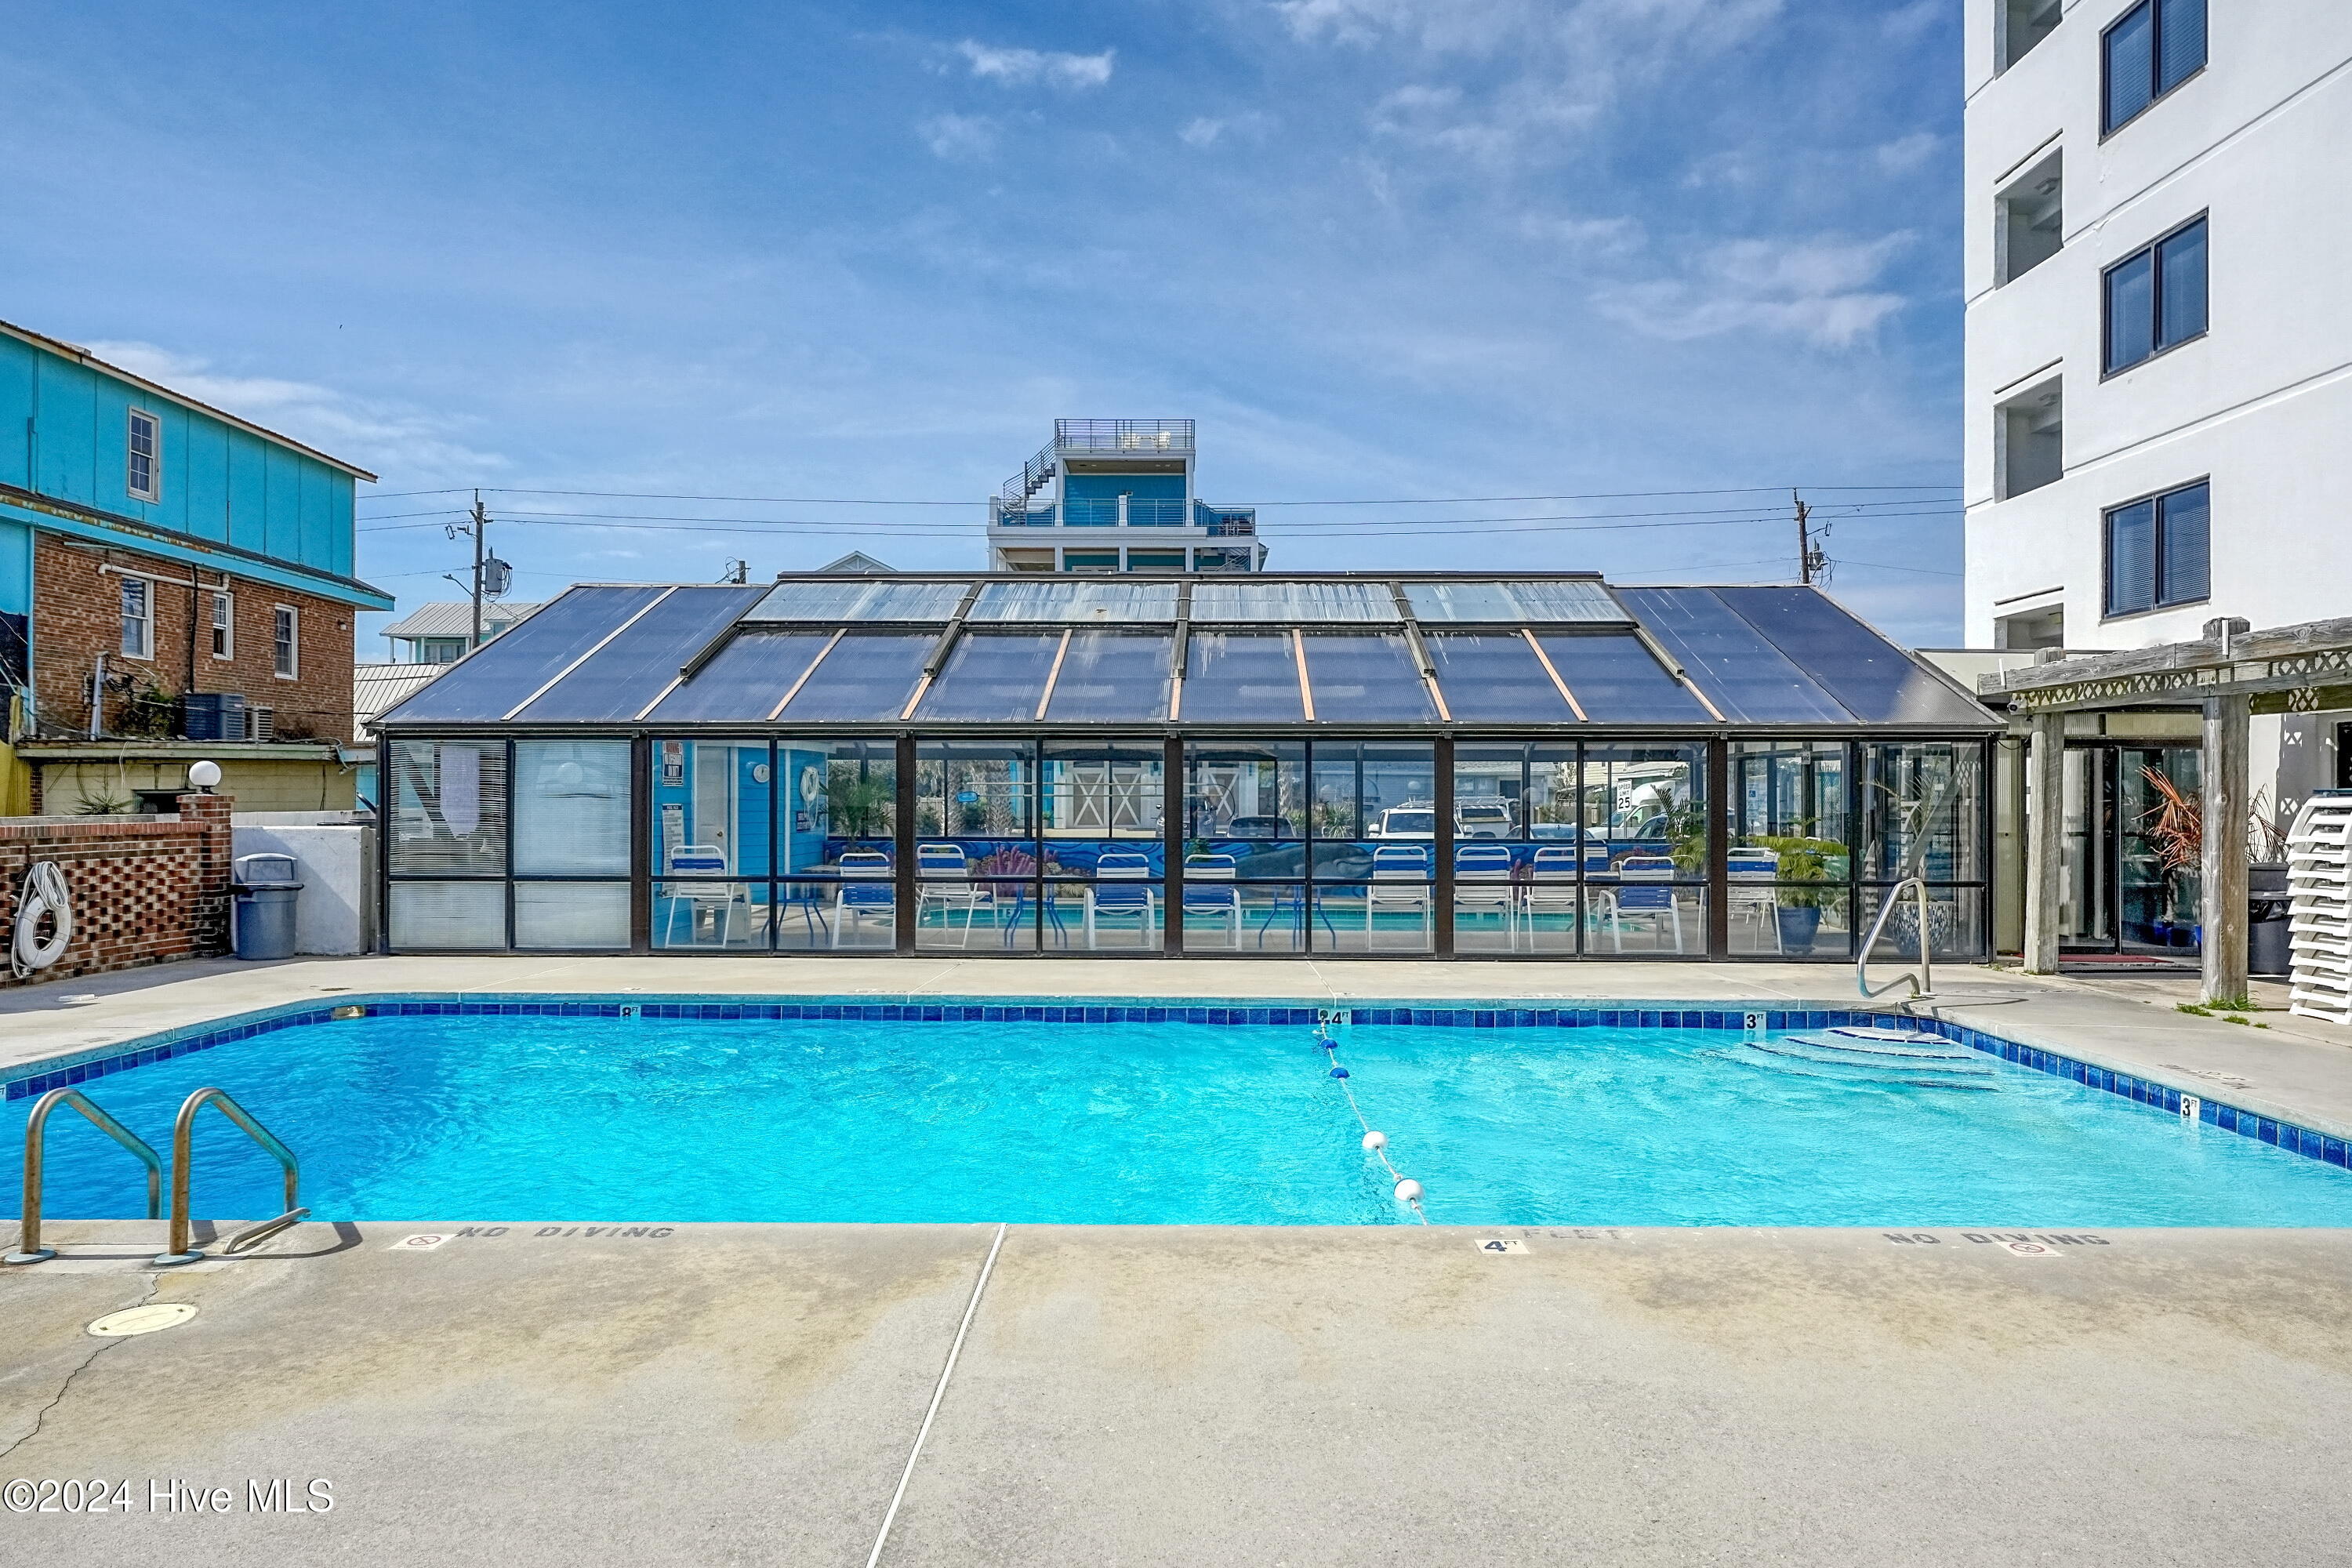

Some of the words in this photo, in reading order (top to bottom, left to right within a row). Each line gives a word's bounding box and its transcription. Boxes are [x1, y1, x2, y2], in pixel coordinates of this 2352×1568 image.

[1618, 797, 1630, 809] 25
[1331, 1012, 1342, 1024] 4
[1747, 1014, 1756, 1029] 3
[2183, 1098, 2190, 1116] 3
[456, 1227, 510, 1237] NO
[533, 1227, 675, 1238] DIVING
[1882, 1233, 1940, 1244] NO
[1960, 1233, 2110, 1245] DIVING
[1484, 1241, 1507, 1252] 4
